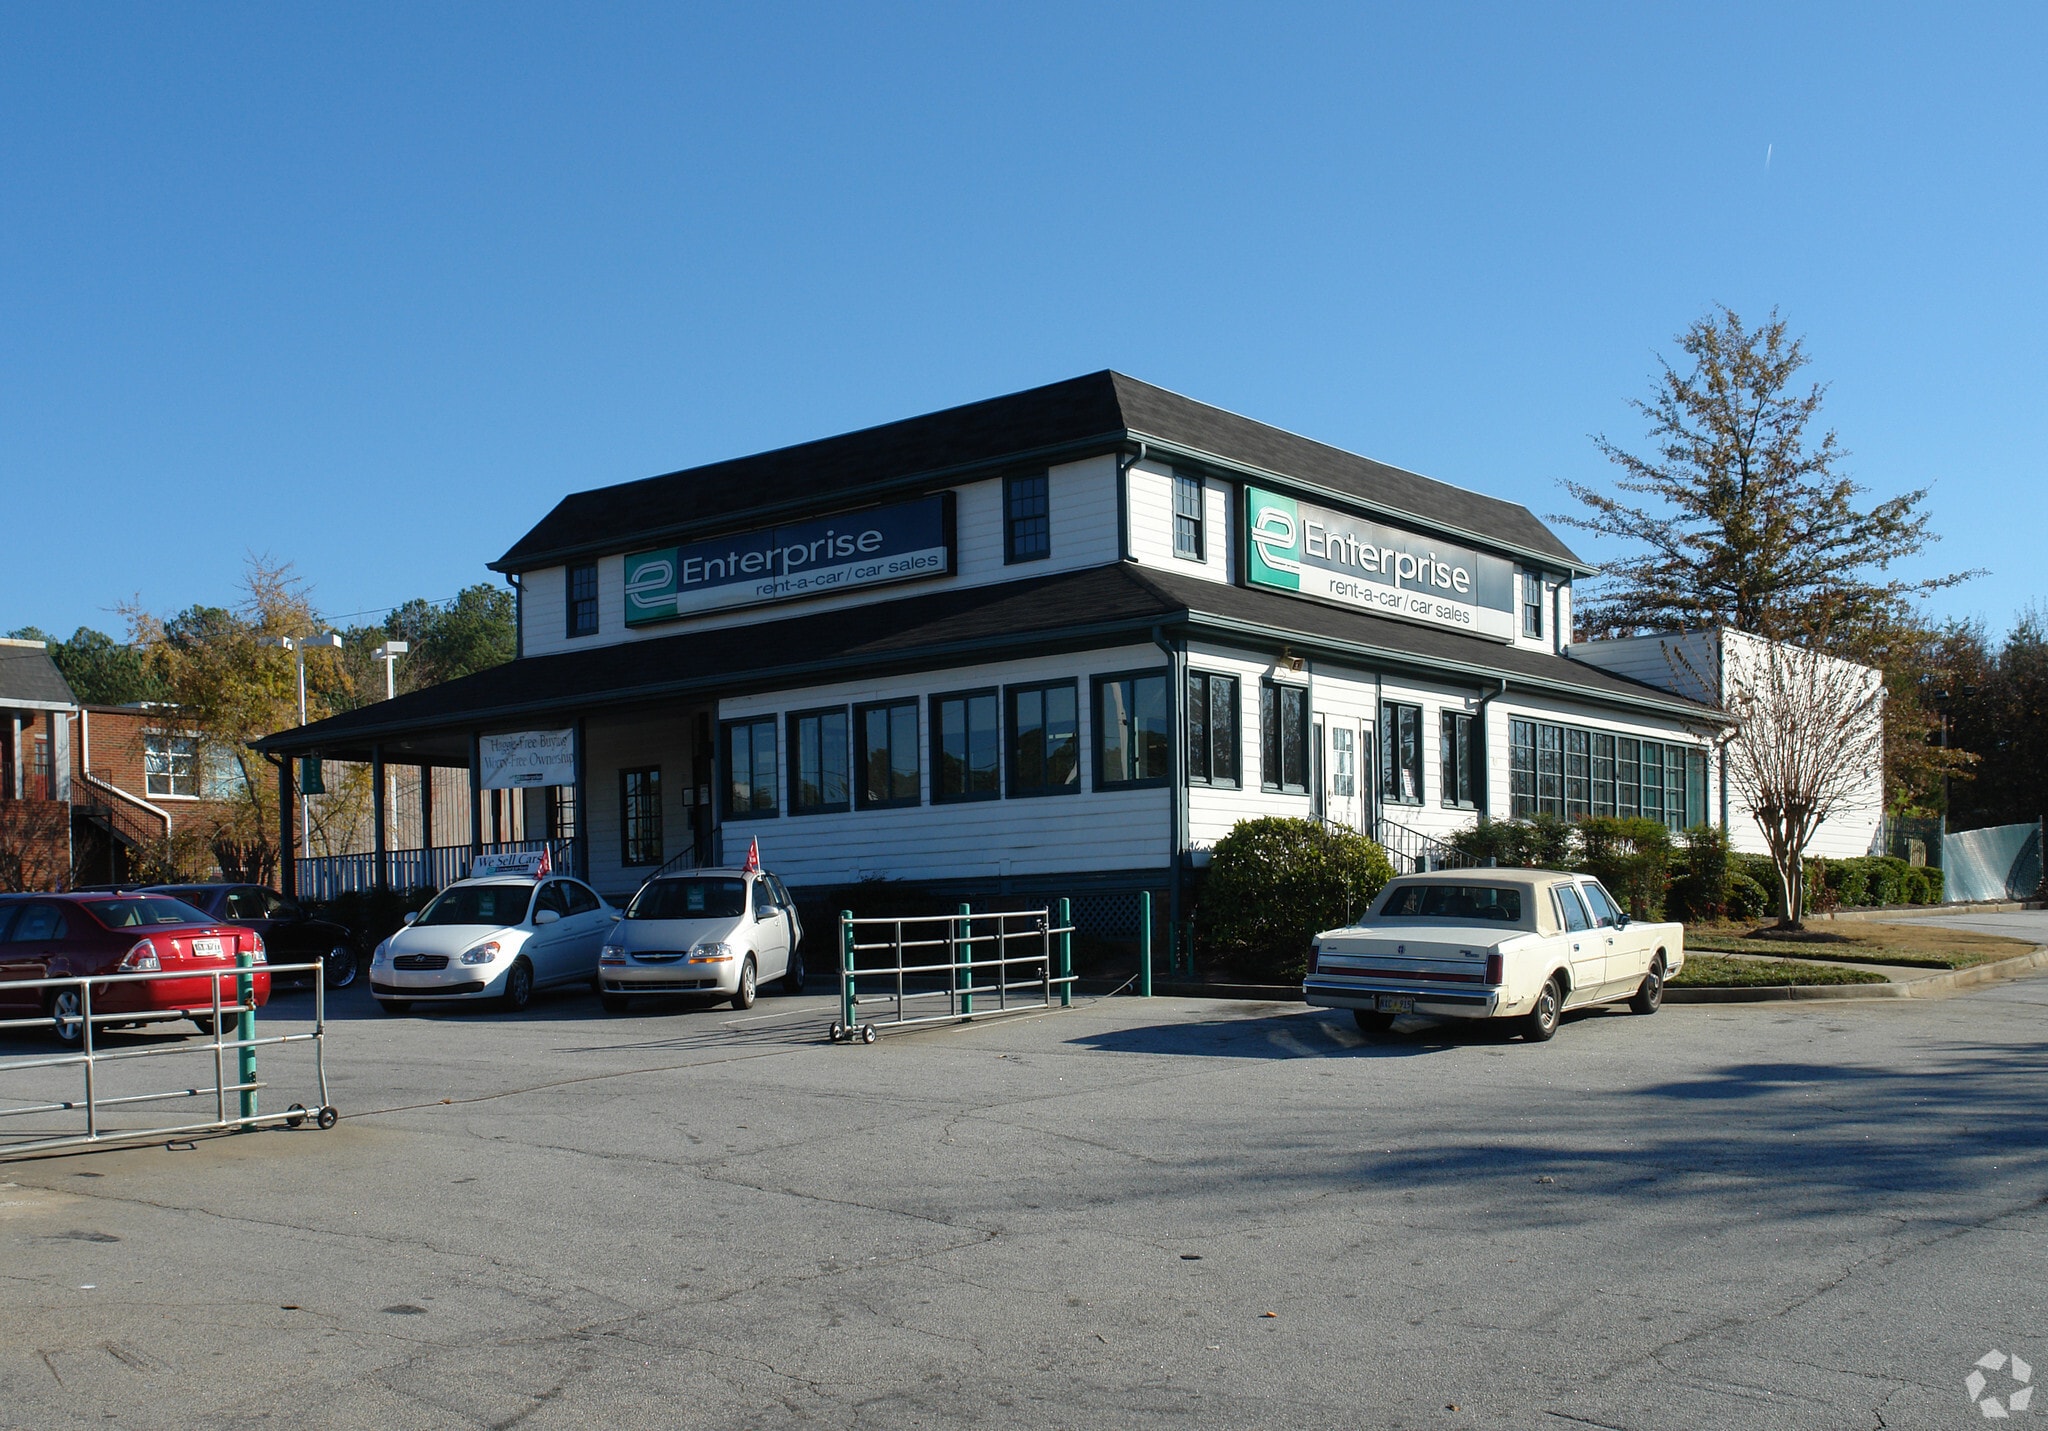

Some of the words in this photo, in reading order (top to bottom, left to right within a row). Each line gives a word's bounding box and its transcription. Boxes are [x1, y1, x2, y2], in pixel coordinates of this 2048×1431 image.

[683, 529, 884, 585] Enterprise
[889, 553, 939, 572] sales
[1303, 519, 1471, 594] Enterprise
[1436, 603, 1471, 624] sales
[479, 857, 494, 867] We
[497, 854, 515, 866] Sell
[519, 854, 543, 865] Cars
